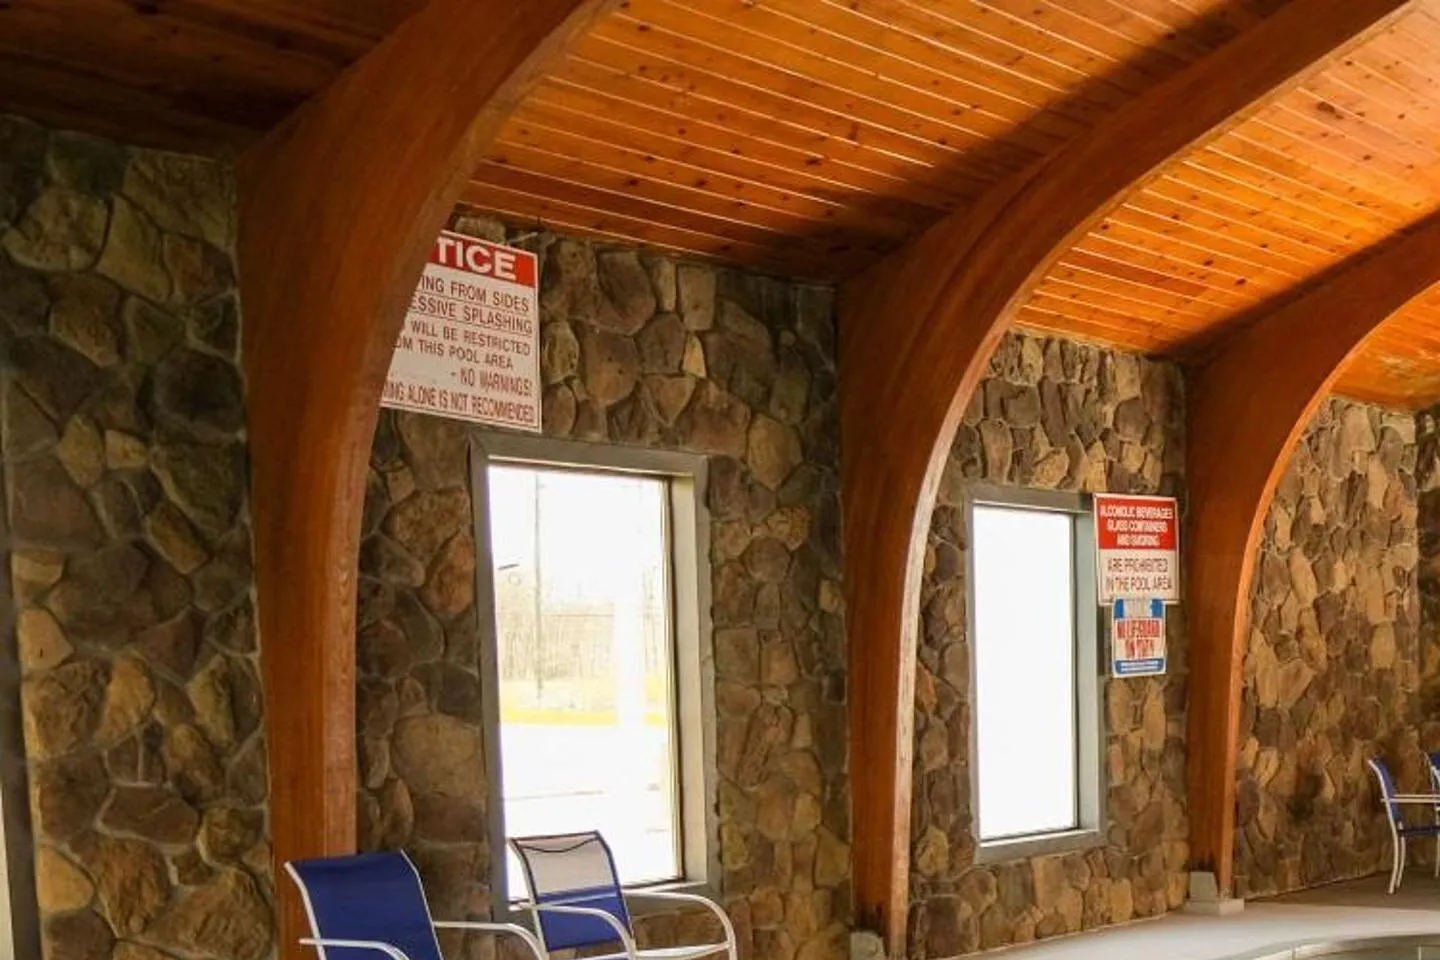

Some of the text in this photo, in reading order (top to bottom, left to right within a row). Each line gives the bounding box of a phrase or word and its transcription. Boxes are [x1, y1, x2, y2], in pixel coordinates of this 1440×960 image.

[451, 281, 487, 302] FROM
[493, 291, 529, 312] SIDES
[463, 304, 533, 335] SPLASHING
[411, 320, 531, 356] WILL BE RESTRICTED
[419, 339, 444, 357] THIS
[449, 345, 480, 364] POOL
[485, 353, 515, 370] AREA
[460, 368, 475, 387] NO
